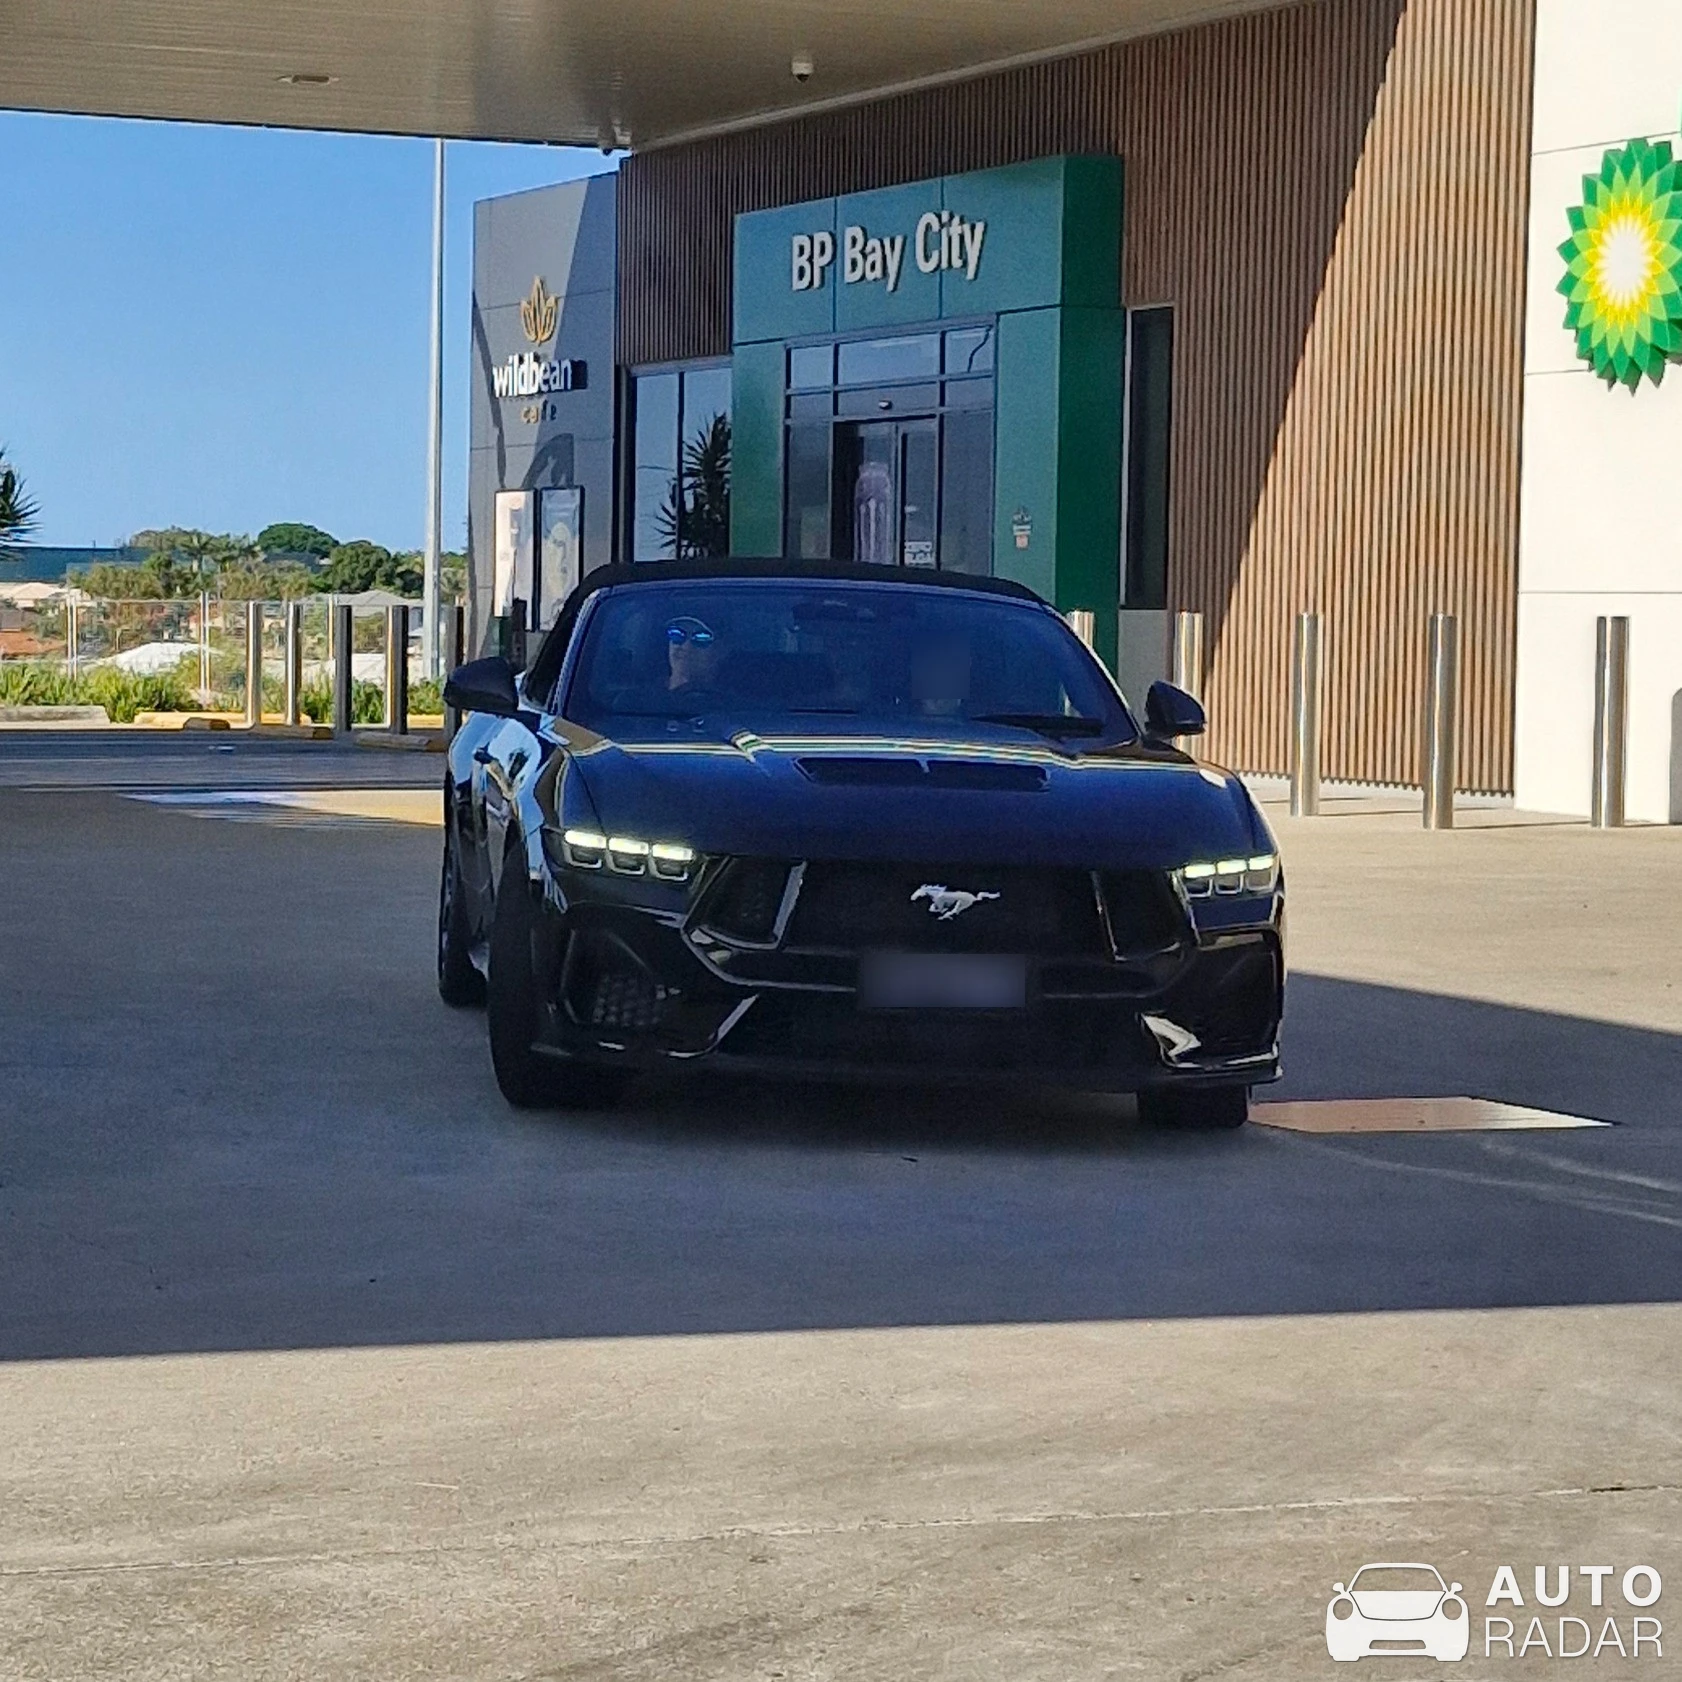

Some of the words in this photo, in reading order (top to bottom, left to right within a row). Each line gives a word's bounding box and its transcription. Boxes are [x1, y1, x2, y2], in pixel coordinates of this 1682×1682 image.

[792, 231, 834, 291] BP
[844, 226, 905, 292] Bay
[915, 210, 985, 281] City
